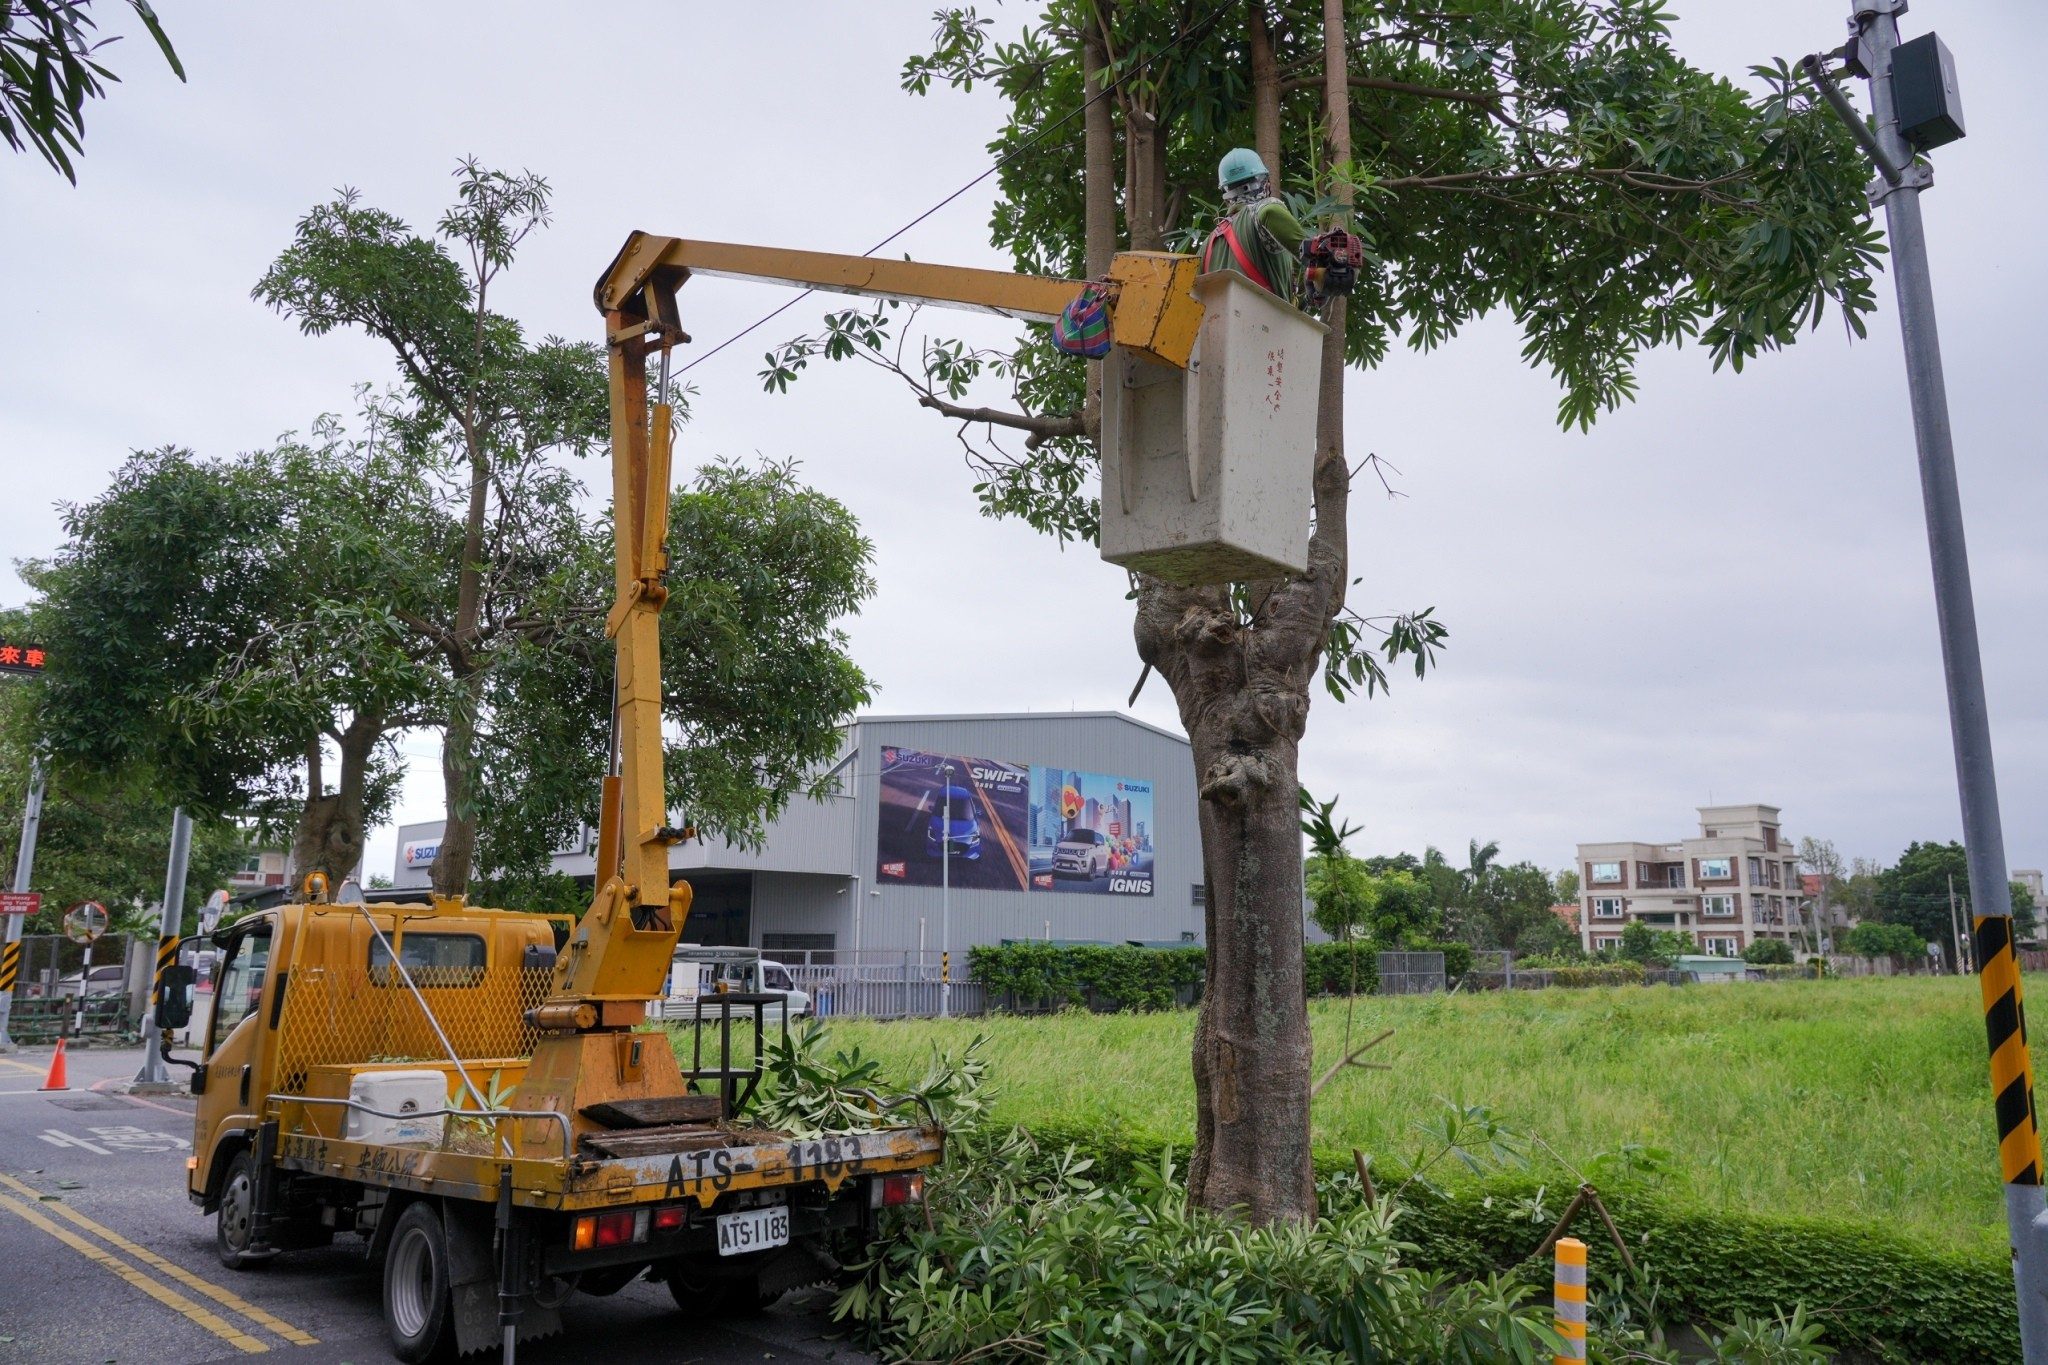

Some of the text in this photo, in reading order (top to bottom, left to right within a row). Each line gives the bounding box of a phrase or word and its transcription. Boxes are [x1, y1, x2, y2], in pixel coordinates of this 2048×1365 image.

[897, 752, 931, 765] SUZUKI
[970, 767, 1026, 784] SWIFT
[1124, 784, 1150, 793] SUZUKI
[1108, 878, 1152, 894] IGNIS
[721, 1215, 788, 1249] ATS-1183
